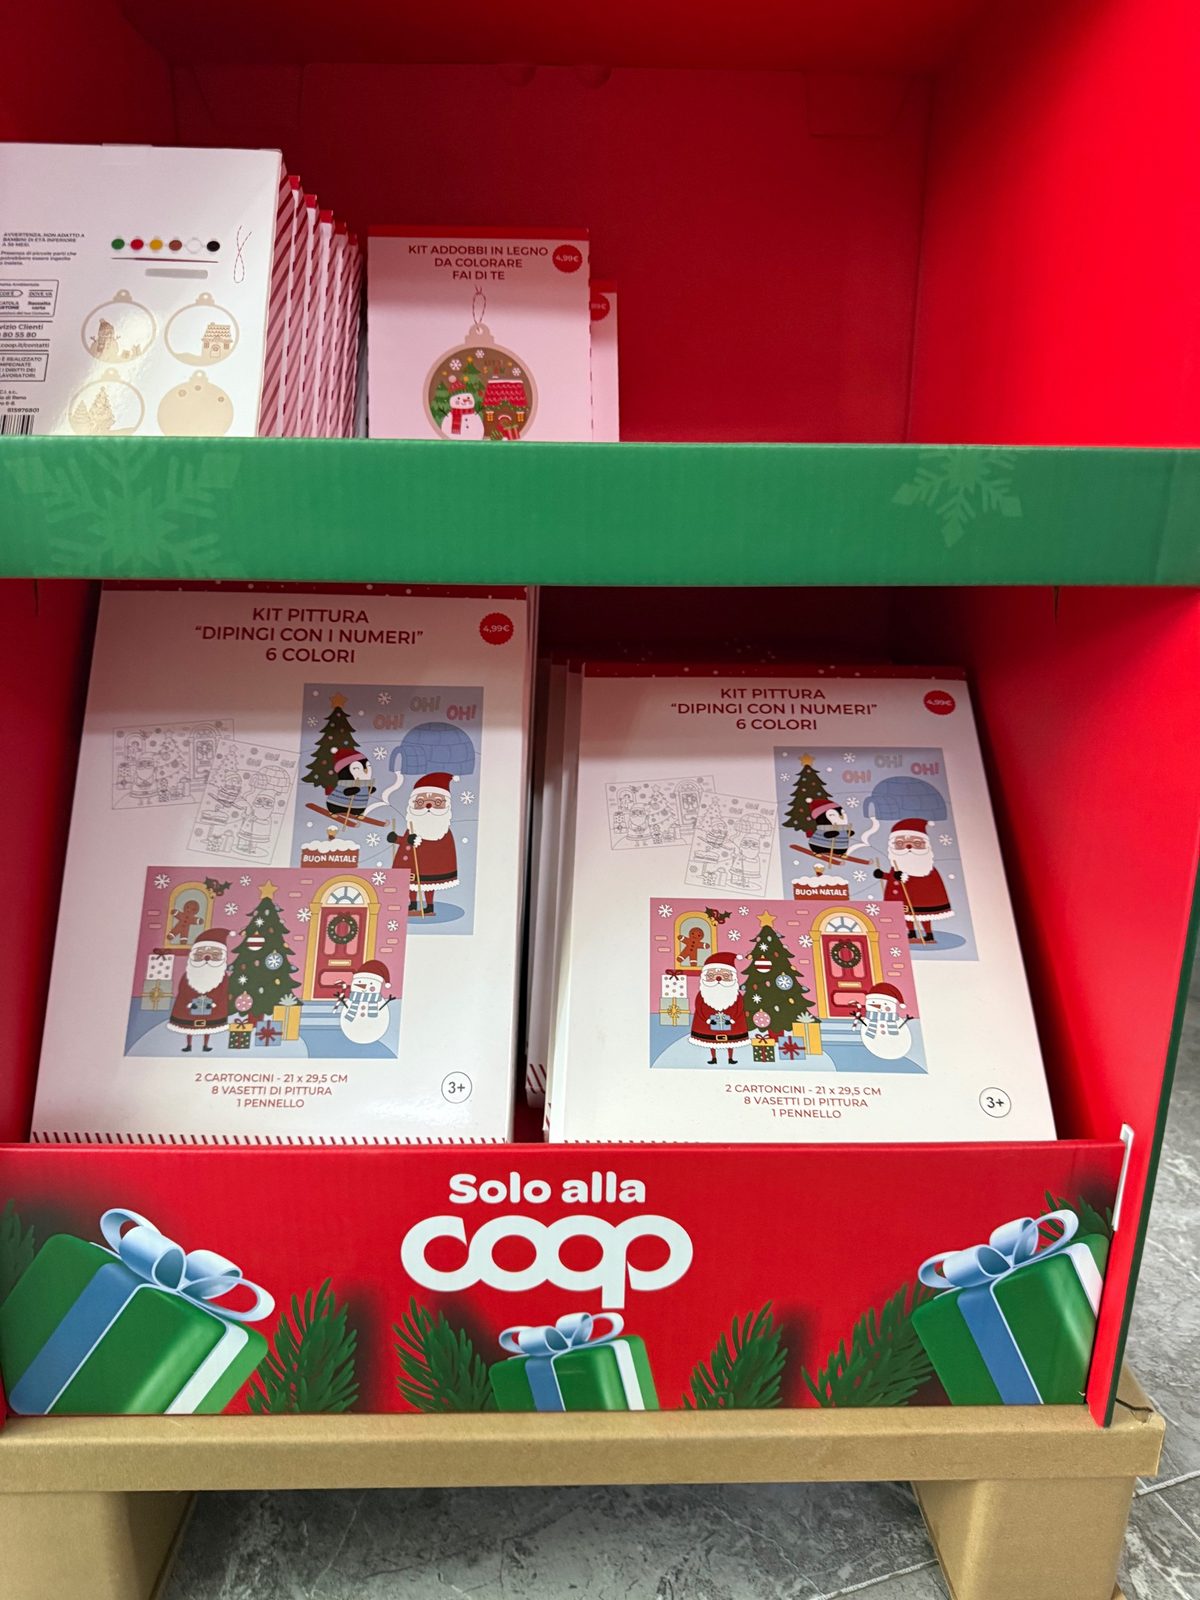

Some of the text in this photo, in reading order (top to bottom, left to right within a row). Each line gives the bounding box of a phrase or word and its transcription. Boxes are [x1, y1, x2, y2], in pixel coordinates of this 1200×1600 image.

[409, 244, 549, 257] KIT ADDOBBI IN LEGNO
[435, 257, 522, 270] DA COLORARE
[453, 270, 505, 280] FAI DI TE
[253, 608, 368, 623] KIT PITTURA
[483, 623, 510, 634] 4,99€
[280, 628, 322, 641] CON
[328, 629, 333, 643] I
[266, 648, 354, 663] 6 COLORI
[721, 689, 825, 700] KIT PITTURA
[408, 696, 441, 712] OH!
[747, 704, 785, 714] CON
[790, 704, 795, 715] I
[447, 704, 477, 721] OH!
[373, 714, 405, 730] OH!
[737, 719, 816, 729] 6 COLORI
[874, 754, 902, 767] OH!
[911, 762, 939, 775] OH!
[842, 770, 871, 783] OH!
[303, 854, 327, 862] BUON
[194, 1072, 202, 1081] 2
[205, 1072, 273, 1082] CARTONCINI
[284, 1073, 293, 1082] 21
[306, 1074, 327, 1083] 29,5
[331, 1074, 347, 1082] CM
[211, 1085, 331, 1096] 8 VASETTI DI PITTURA
[448, 1082, 465, 1093] 3+
[726, 1084, 731, 1092] 2
[735, 1085, 805, 1093] CARTONCINI
[816, 1086, 825, 1094] 21
[839, 1087, 860, 1095] 29,5
[863, 1087, 881, 1095] CM
[237, 1098, 304, 1107] 1 PENNELLO
[744, 1096, 751, 1104] 8
[754, 1097, 799, 1105] VASETTI
[819, 1098, 868, 1107] PITTURA
[987, 1097, 1004, 1108] 3+
[771, 1109, 841, 1118] 1 PENNELLO
[449, 1171, 647, 1204] Solo alla
[400, 1214, 694, 1309] coop
